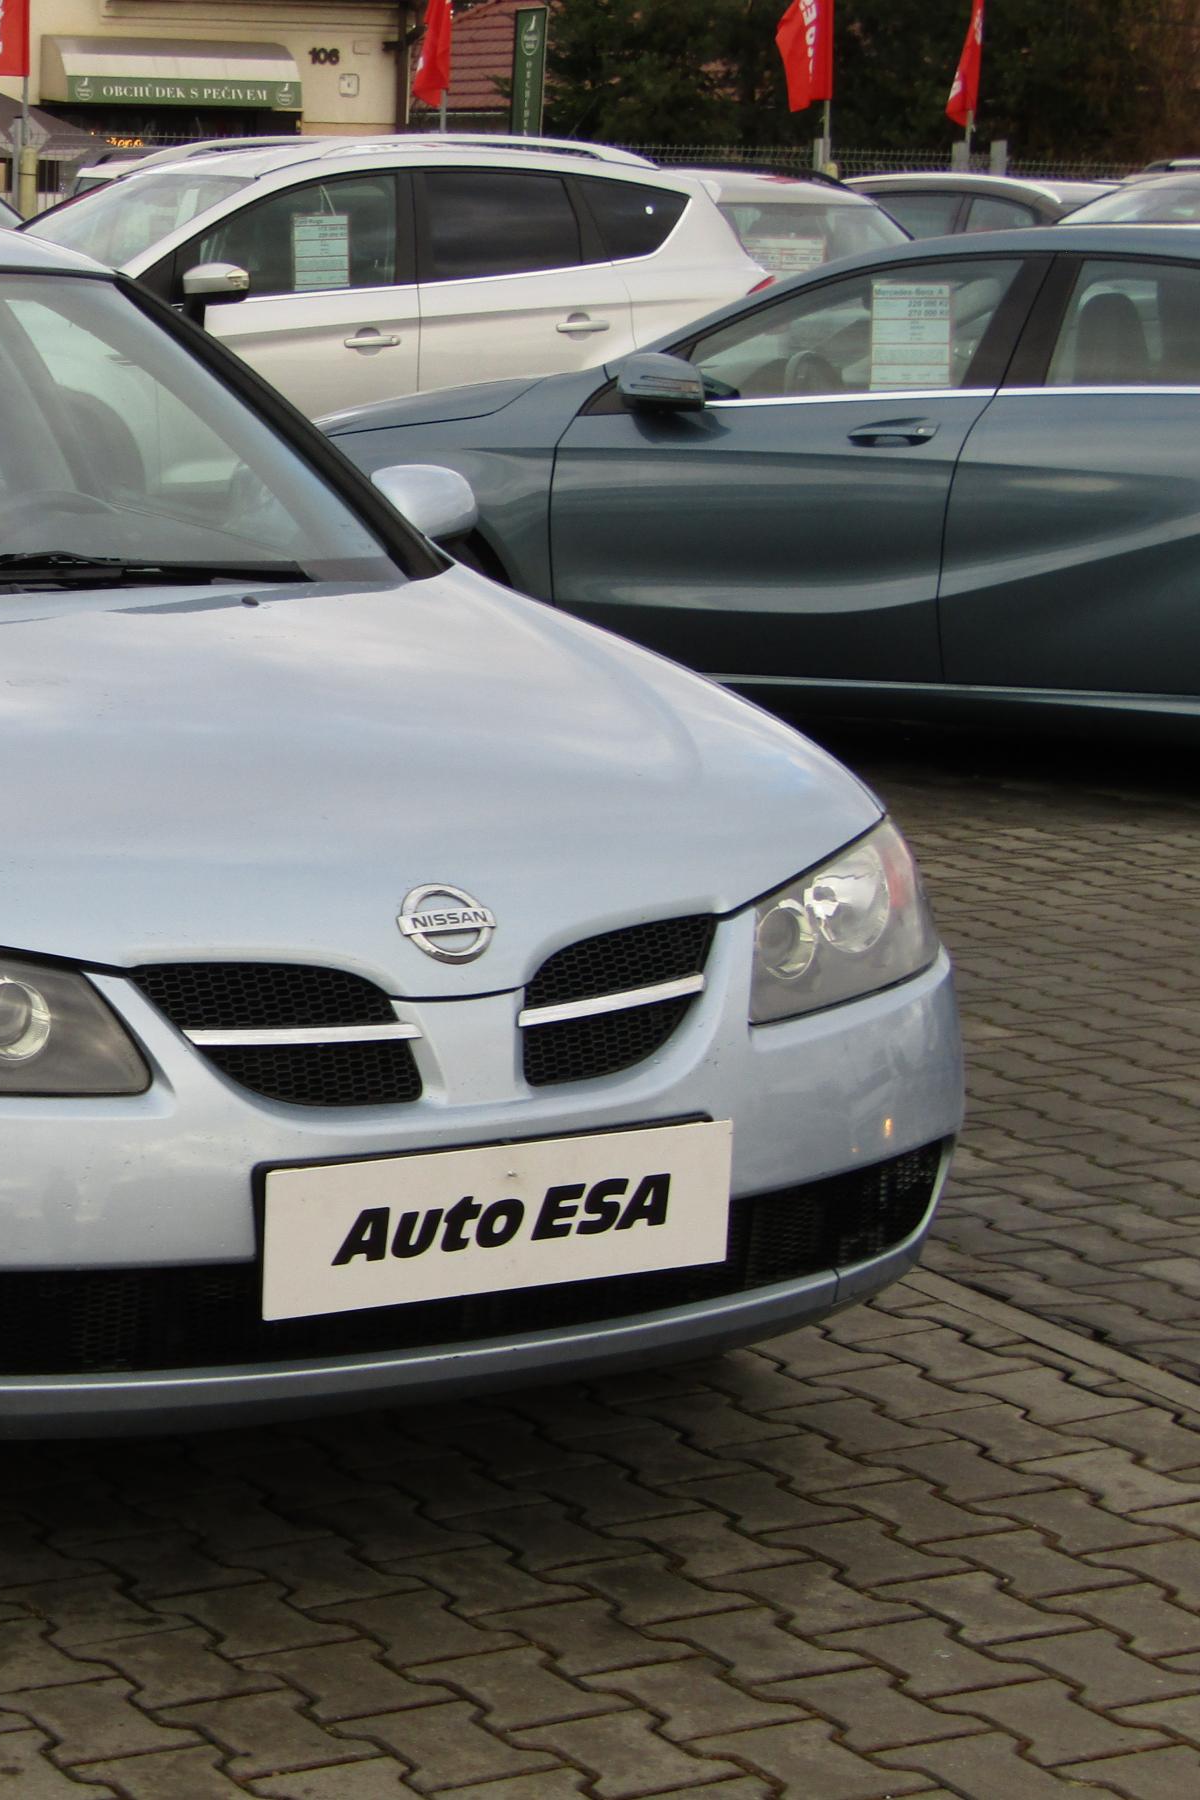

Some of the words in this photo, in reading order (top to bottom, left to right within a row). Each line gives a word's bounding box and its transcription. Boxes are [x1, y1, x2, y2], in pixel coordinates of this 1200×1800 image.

[309, 47, 340, 65] 106
[102, 83, 186, 98] OBCHŮDEK
[190, 87, 199, 98] S
[203, 86, 267, 101] PEČIVEM
[412, 910, 488, 929] NISSAN
[331, 1196, 525, 1266] Auto
[531, 1173, 671, 1241] ESA
